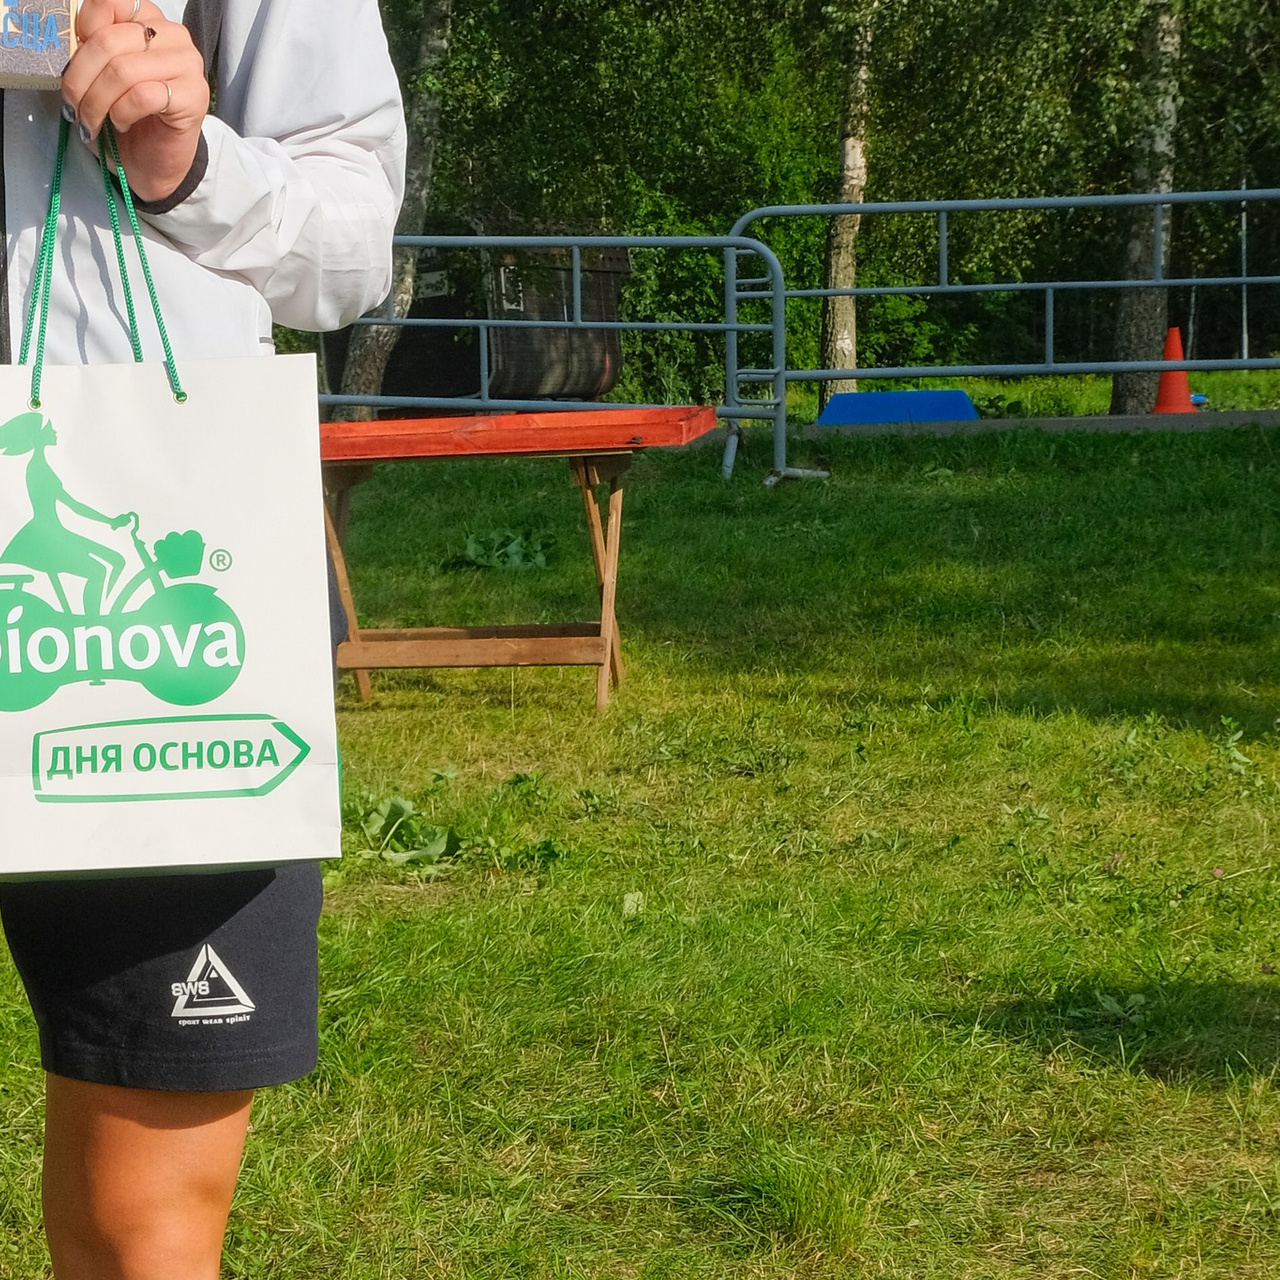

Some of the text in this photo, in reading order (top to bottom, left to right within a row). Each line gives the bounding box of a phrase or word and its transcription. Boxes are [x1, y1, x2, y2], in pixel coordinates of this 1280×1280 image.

[47, 739, 280, 780] ДНЯ ОСНОВА
[171, 980, 210, 996] SWS
